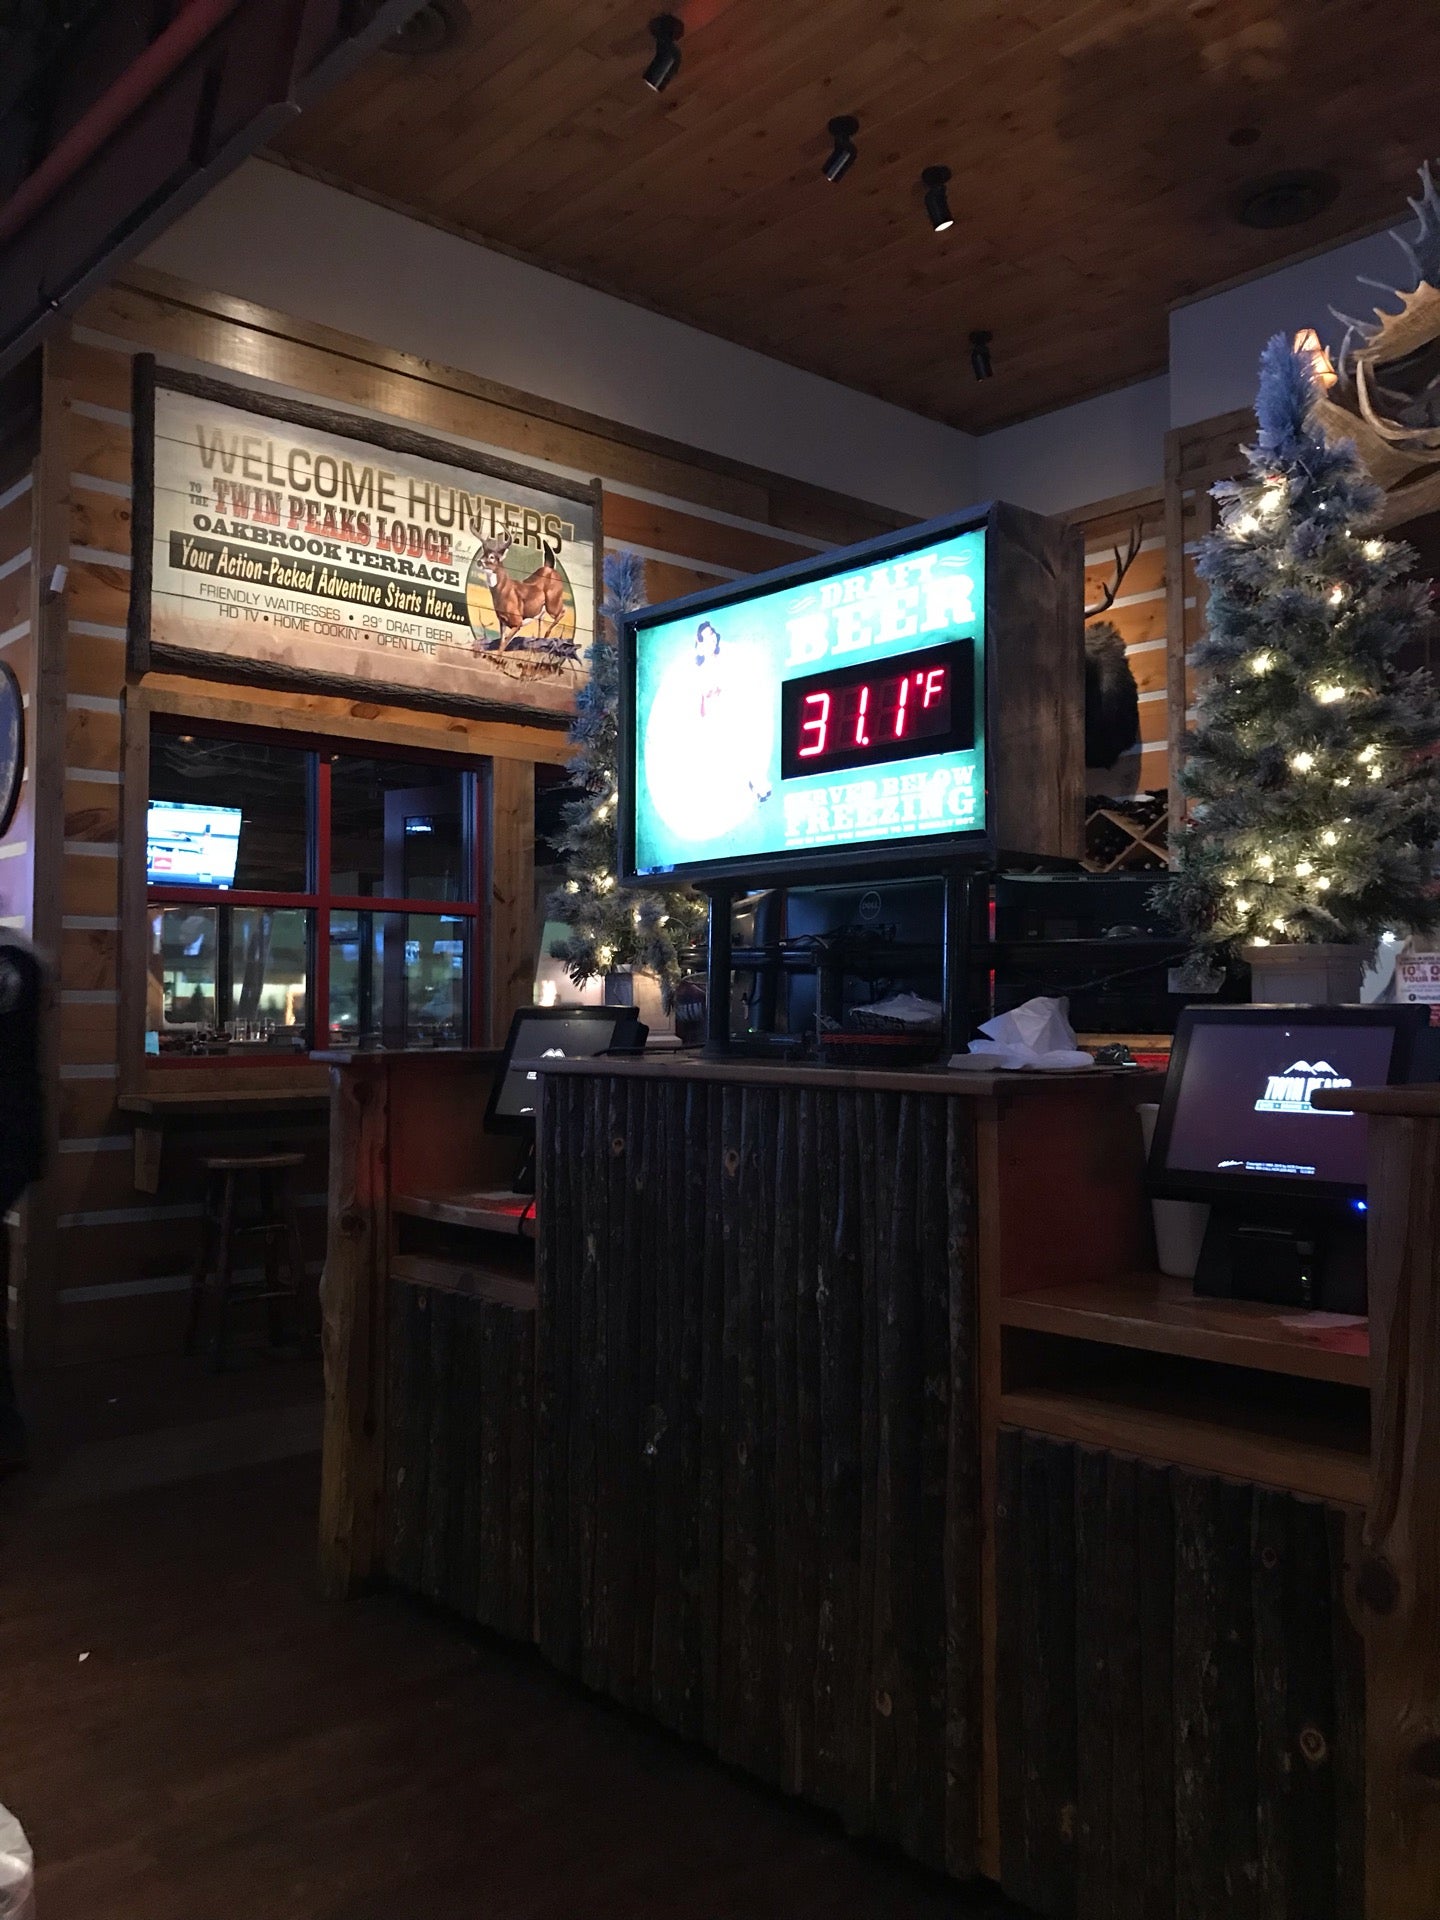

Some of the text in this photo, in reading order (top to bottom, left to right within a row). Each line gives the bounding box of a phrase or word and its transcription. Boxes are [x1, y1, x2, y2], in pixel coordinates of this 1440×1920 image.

[189, 481, 202, 493] TO
[190, 494, 209, 507] THE
[196, 425, 563, 554] WELCOME HUNTERS
[193, 514, 342, 561] OAKBROOK
[346, 547, 460, 587] TERRACE
[213, 477, 283, 526] TWIN
[287, 495, 371, 546] PEAKS
[376, 515, 453, 566] LODGE
[181, 537, 465, 622] Your Action-Packed Adventure Starts Here...
[819, 553, 938, 608] DRAFT
[199, 583, 453, 642] FRIENDLY WAITRESSES 29° DRAFT BEER
[219, 605, 239, 619] HD
[243, 608, 259, 623] TV
[273, 615, 310, 632] HOME
[377, 634, 408, 650] OPEN
[411, 641, 437, 656] LATE
[785, 574, 976, 667] BEER
[784, 781, 878, 806] RVED
